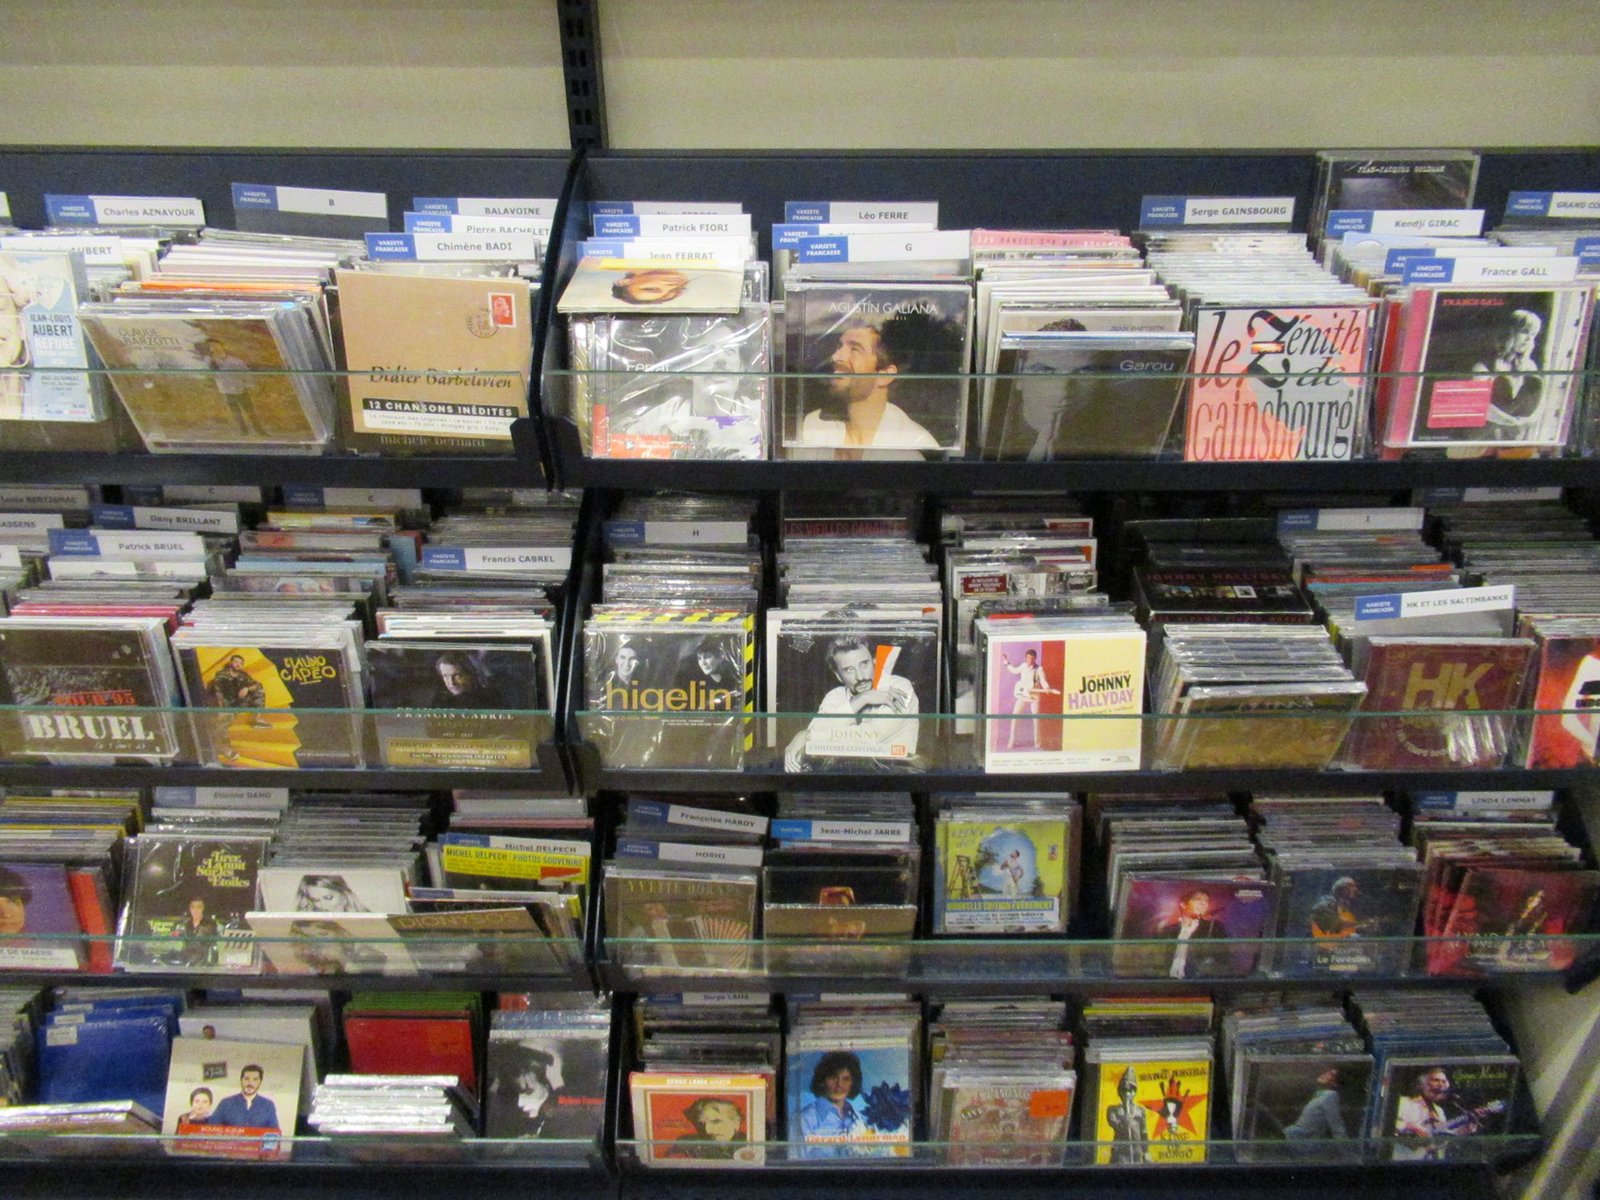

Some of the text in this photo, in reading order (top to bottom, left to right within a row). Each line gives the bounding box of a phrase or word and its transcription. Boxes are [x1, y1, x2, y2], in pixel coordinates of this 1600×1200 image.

[328, 198, 335, 206] B
[104, 208, 195, 217] Charles AZNAVOUR
[484, 207, 541, 215] BALAVOINE
[859, 211, 875, 219] Léo
[1191, 206, 1287, 217] Serge GAINSBOURG
[662, 223, 729, 232] Patrick FIORI
[1394, 218, 1460, 228] Kendji GIRAC
[466, 225, 551, 237] Pierre BACHELET
[437, 241, 513, 251] Chimène BADI
[905, 243, 912, 251] G
[649, 252, 714, 260] Jean FERRAT
[1481, 266, 1548, 276] France GALL
[883, 303, 938, 314] GALIANA
[30, 313, 72, 322] JEAN-LOUIS
[32, 324, 73, 336] AUBERT
[1120, 359, 1174, 371] Garou
[369, 366, 512, 389] Didier Barbelivien
[369, 400, 513, 417] 12 CHANSONS INÉDITES
[151, 515, 221, 525] Dany BRILLANT
[482, 555, 555, 563] Francis CABREL
[1450, 594, 1509, 605] SALTIMBANKS
[284, 655, 326, 668] CLAUDIO
[1079, 674, 1131, 694] JOHNNY
[1401, 662, 1495, 710] HK
[606, 680, 732, 713] higelin
[1068, 690, 1134, 710] HALLYDAY
[28, 715, 155, 740] BRUEL
[829, 729, 880, 740] JOHNNY
[681, 813, 755, 827] Françoise HARDY
[820, 827, 871, 835] Jean-Michel
[536, 845, 577, 853] DELPECH
[446, 849, 473, 859] MICHEL
[475, 851, 507, 860] DELPECH
[513, 855, 541, 863] PHOTOS
[695, 852, 725, 860] HOSHI
